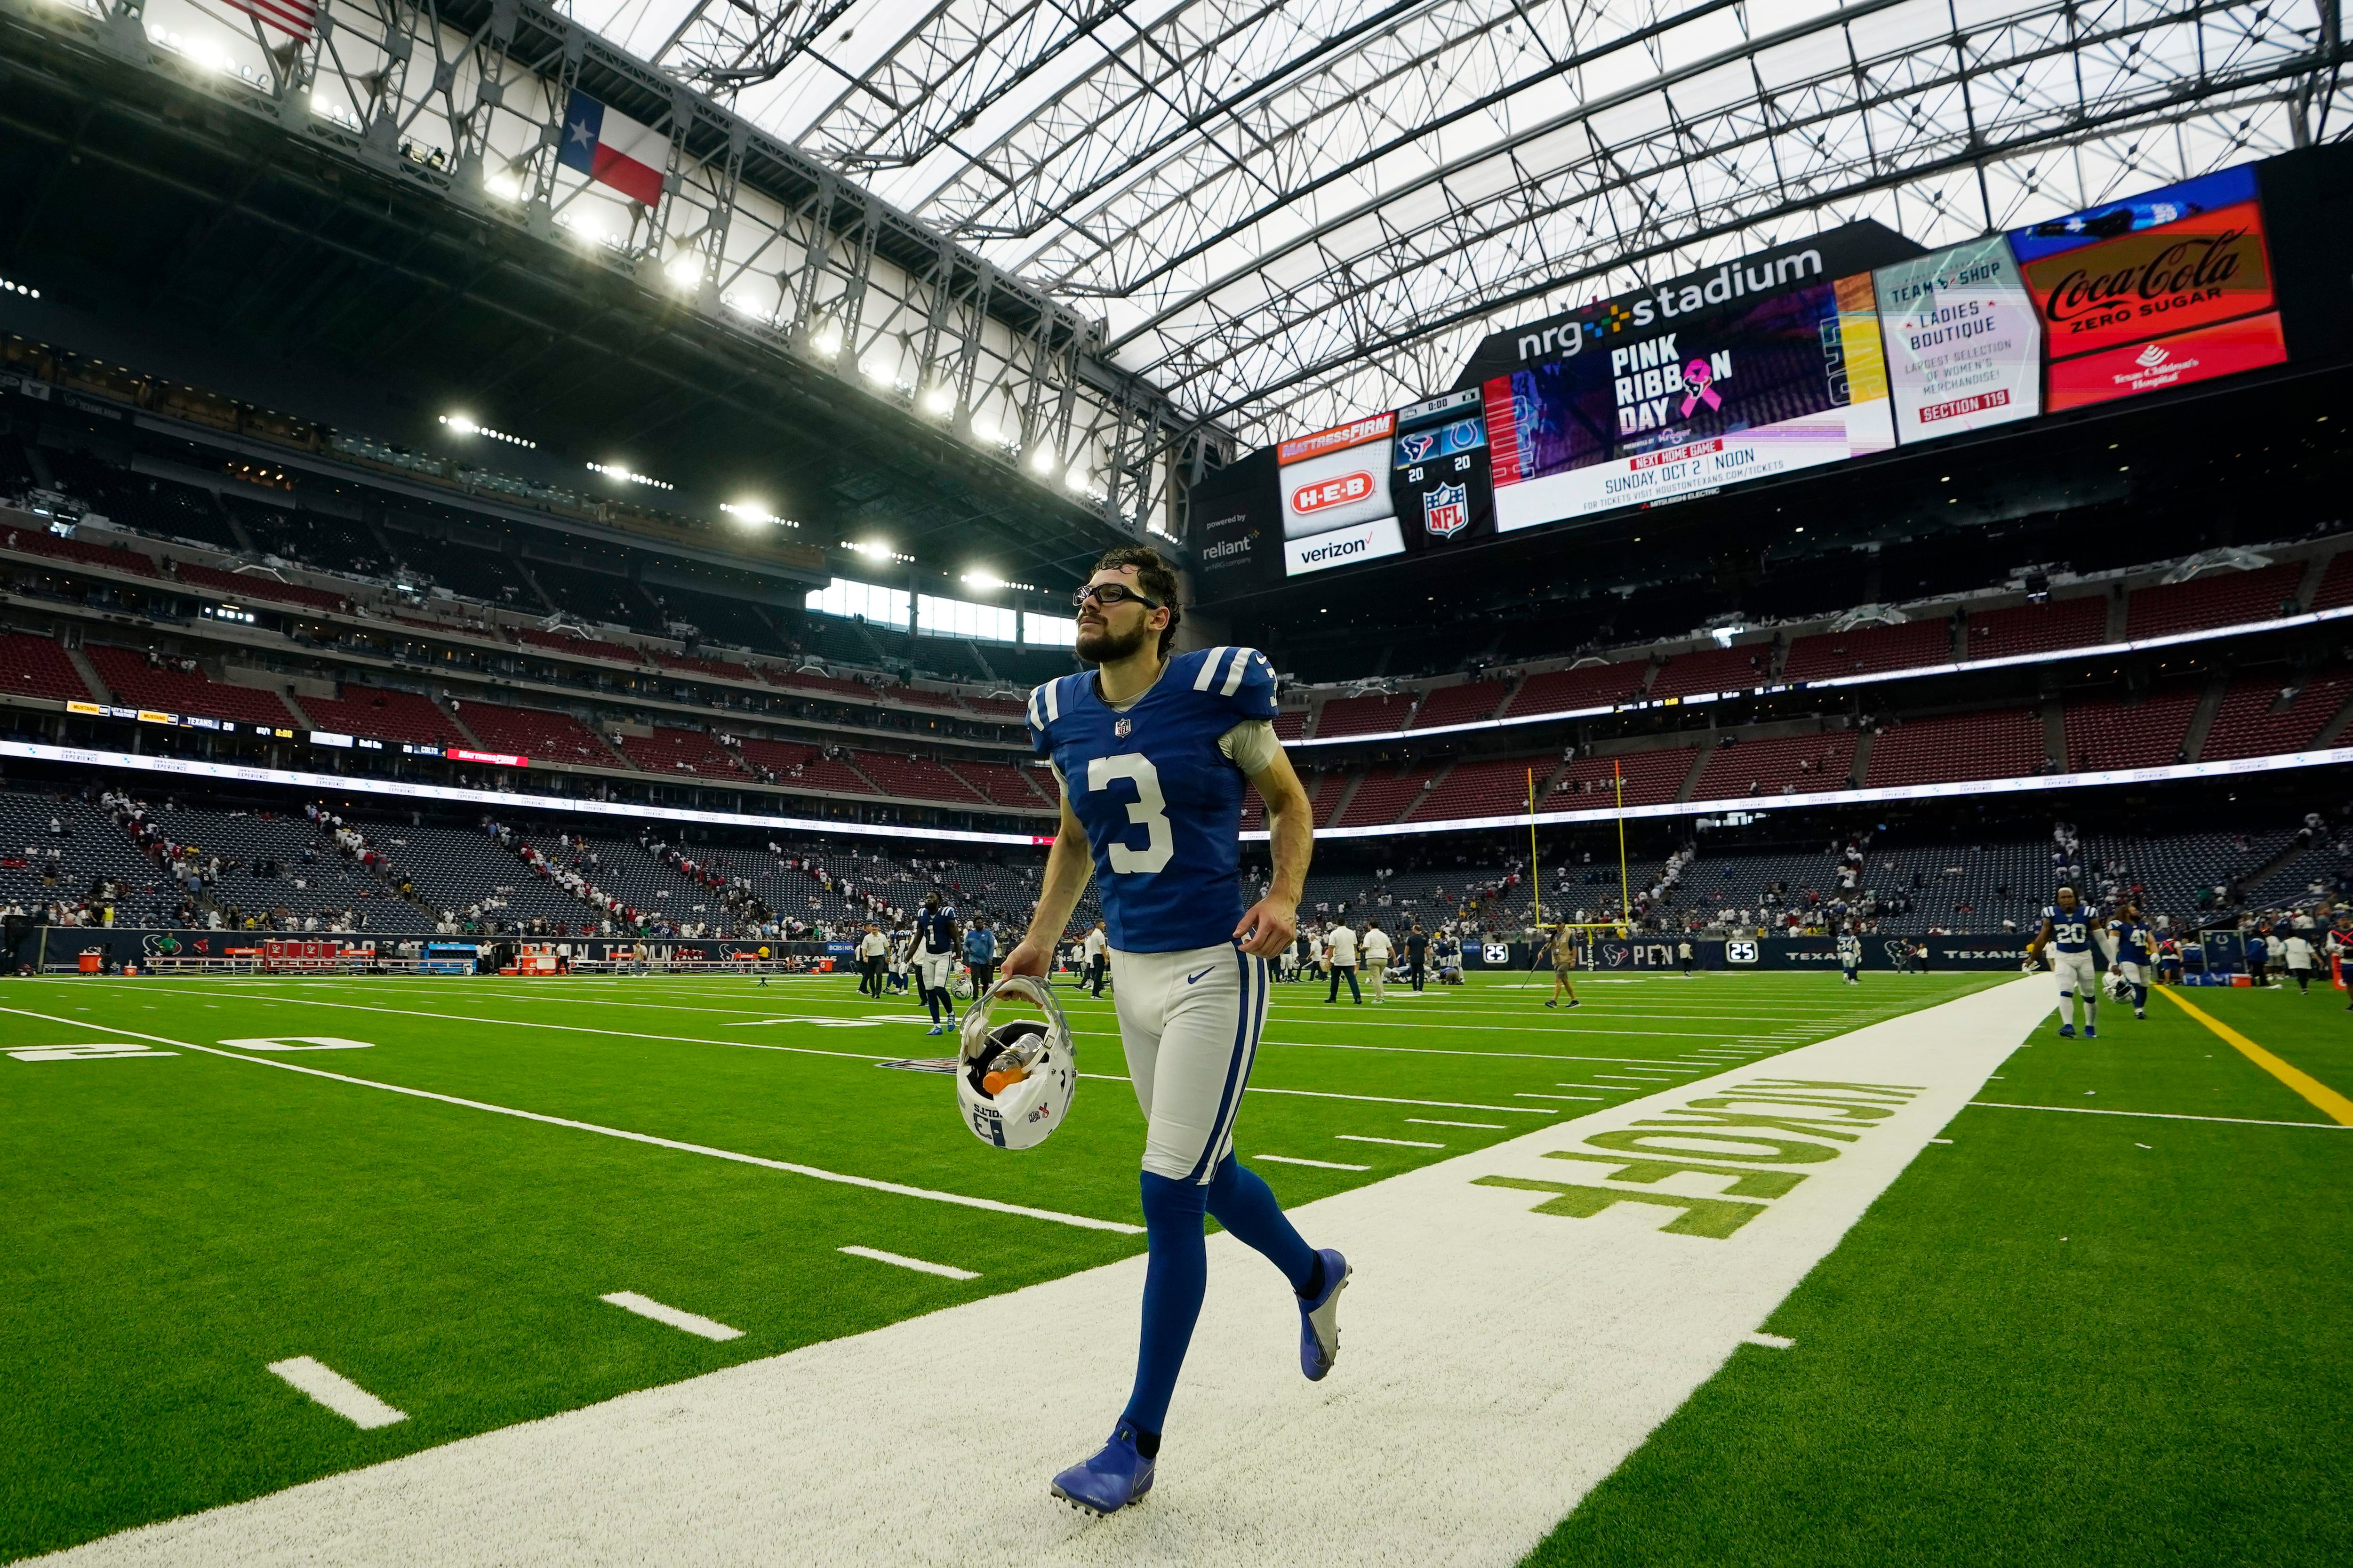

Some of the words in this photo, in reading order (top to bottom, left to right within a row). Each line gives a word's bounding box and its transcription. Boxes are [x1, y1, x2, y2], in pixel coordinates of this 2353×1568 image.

[1892, 281, 1933, 304] TEAM
[1960, 262, 2000, 285] SHOP
[2046, 225, 2249, 322] Coca-Cola
[1518, 322, 1582, 360] nrg
[1633, 249, 1823, 326] stadium
[1921, 301, 1979, 328] LADIES
[2071, 310, 2131, 333] ZERO
[2139, 286, 2222, 317] SUGAR
[1911, 316, 1996, 350] BOUTIQUE
[1612, 333, 1681, 377] PINK
[1905, 355, 1949, 374] LARGEST
[1954, 339, 2012, 360] SELECTION
[1928, 369, 1939, 381] OF
[1944, 358, 1993, 376] WOMEN'S
[2113, 372, 2143, 384] Texas
[2132, 372, 2178, 390] Hospital
[1429, 398, 1448, 411] 0:00
[1923, 399, 1978, 422] SECTION
[1984, 391, 2004, 408] 119
[1618, 397, 1669, 436] DAY
[1455, 455, 1471, 471] 20
[1636, 455, 1659, 469] NEXT
[1662, 447, 1689, 464] HOME
[1690, 440, 1716, 458] GAME
[1409, 466, 1424, 483] 20
[1606, 471, 1657, 494] SUNDAY,
[1662, 462, 1686, 482] OCT
[1694, 461, 1700, 475] 2
[1715, 448, 1755, 472] NOON
[1584, 501, 1598, 511] FOR
[1601, 494, 1632, 507] TICKETS
[1634, 489, 1653, 500] VISIT
[1656, 460, 1785, 495] HOUSTONTEXANS.COM/TICKETS
[1688, 488, 1720, 500] ELECTRIC
[1207, 515, 1236, 530] powered
[1237, 514, 1246, 522] by
[1430, 505, 1463, 530] NFL
[1203, 536, 1251, 560] reliant
[1301, 538, 1365, 563] verizon
[187, 716, 213, 727] TEXANS
[1118, 727, 1128, 735] NFL
[223, 722, 234, 731] 20
[275, 728, 293, 738] 0:00
[421, 746, 438, 754] COLTS
[61, 753, 97, 762] EXPERIENCE
[153, 763, 186, 771] EXPERIENCE
[238, 772, 269, 780] EXPERIENCE
[1087, 753, 1174, 874] 3
[927, 925, 936, 945] 1
[2054, 923, 2087, 944] 20
[603, 944, 682, 968] TEAN
[1486, 945, 1505, 960] 25
[1633, 945, 1673, 965] PEN
[1730, 943, 1754, 960] 25
[1943, 950, 2029, 959] TEXANS
[974, 1103, 1004, 1118] OLTS
[1469, 1078, 1927, 1240] KICKOFF
